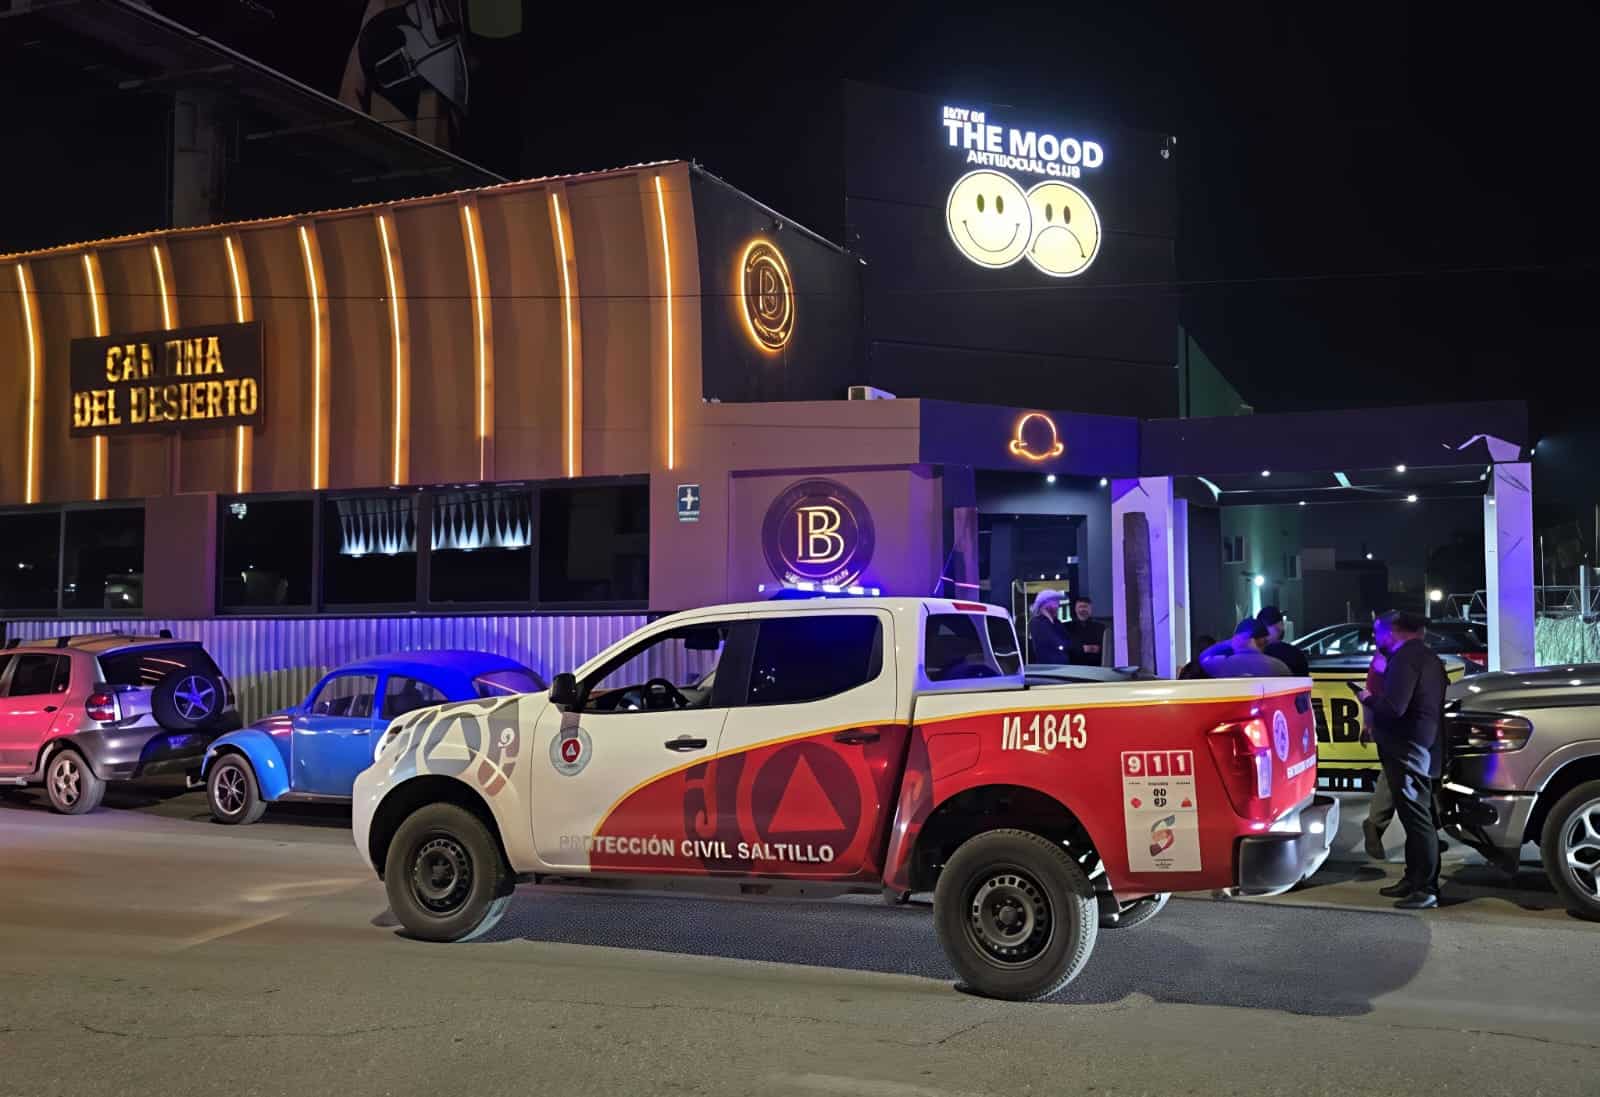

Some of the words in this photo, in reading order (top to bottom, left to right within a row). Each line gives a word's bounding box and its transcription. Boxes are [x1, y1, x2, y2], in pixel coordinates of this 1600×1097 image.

[943, 118, 1003, 152] THE
[1009, 129, 1104, 168] MOOD
[73, 388, 122, 427] DEL
[130, 377, 258, 424] DESIERTO
[1001, 713, 1087, 750] M-1843
[681, 840, 732, 859] CIVIL
[737, 842, 834, 862] SALTILLO
